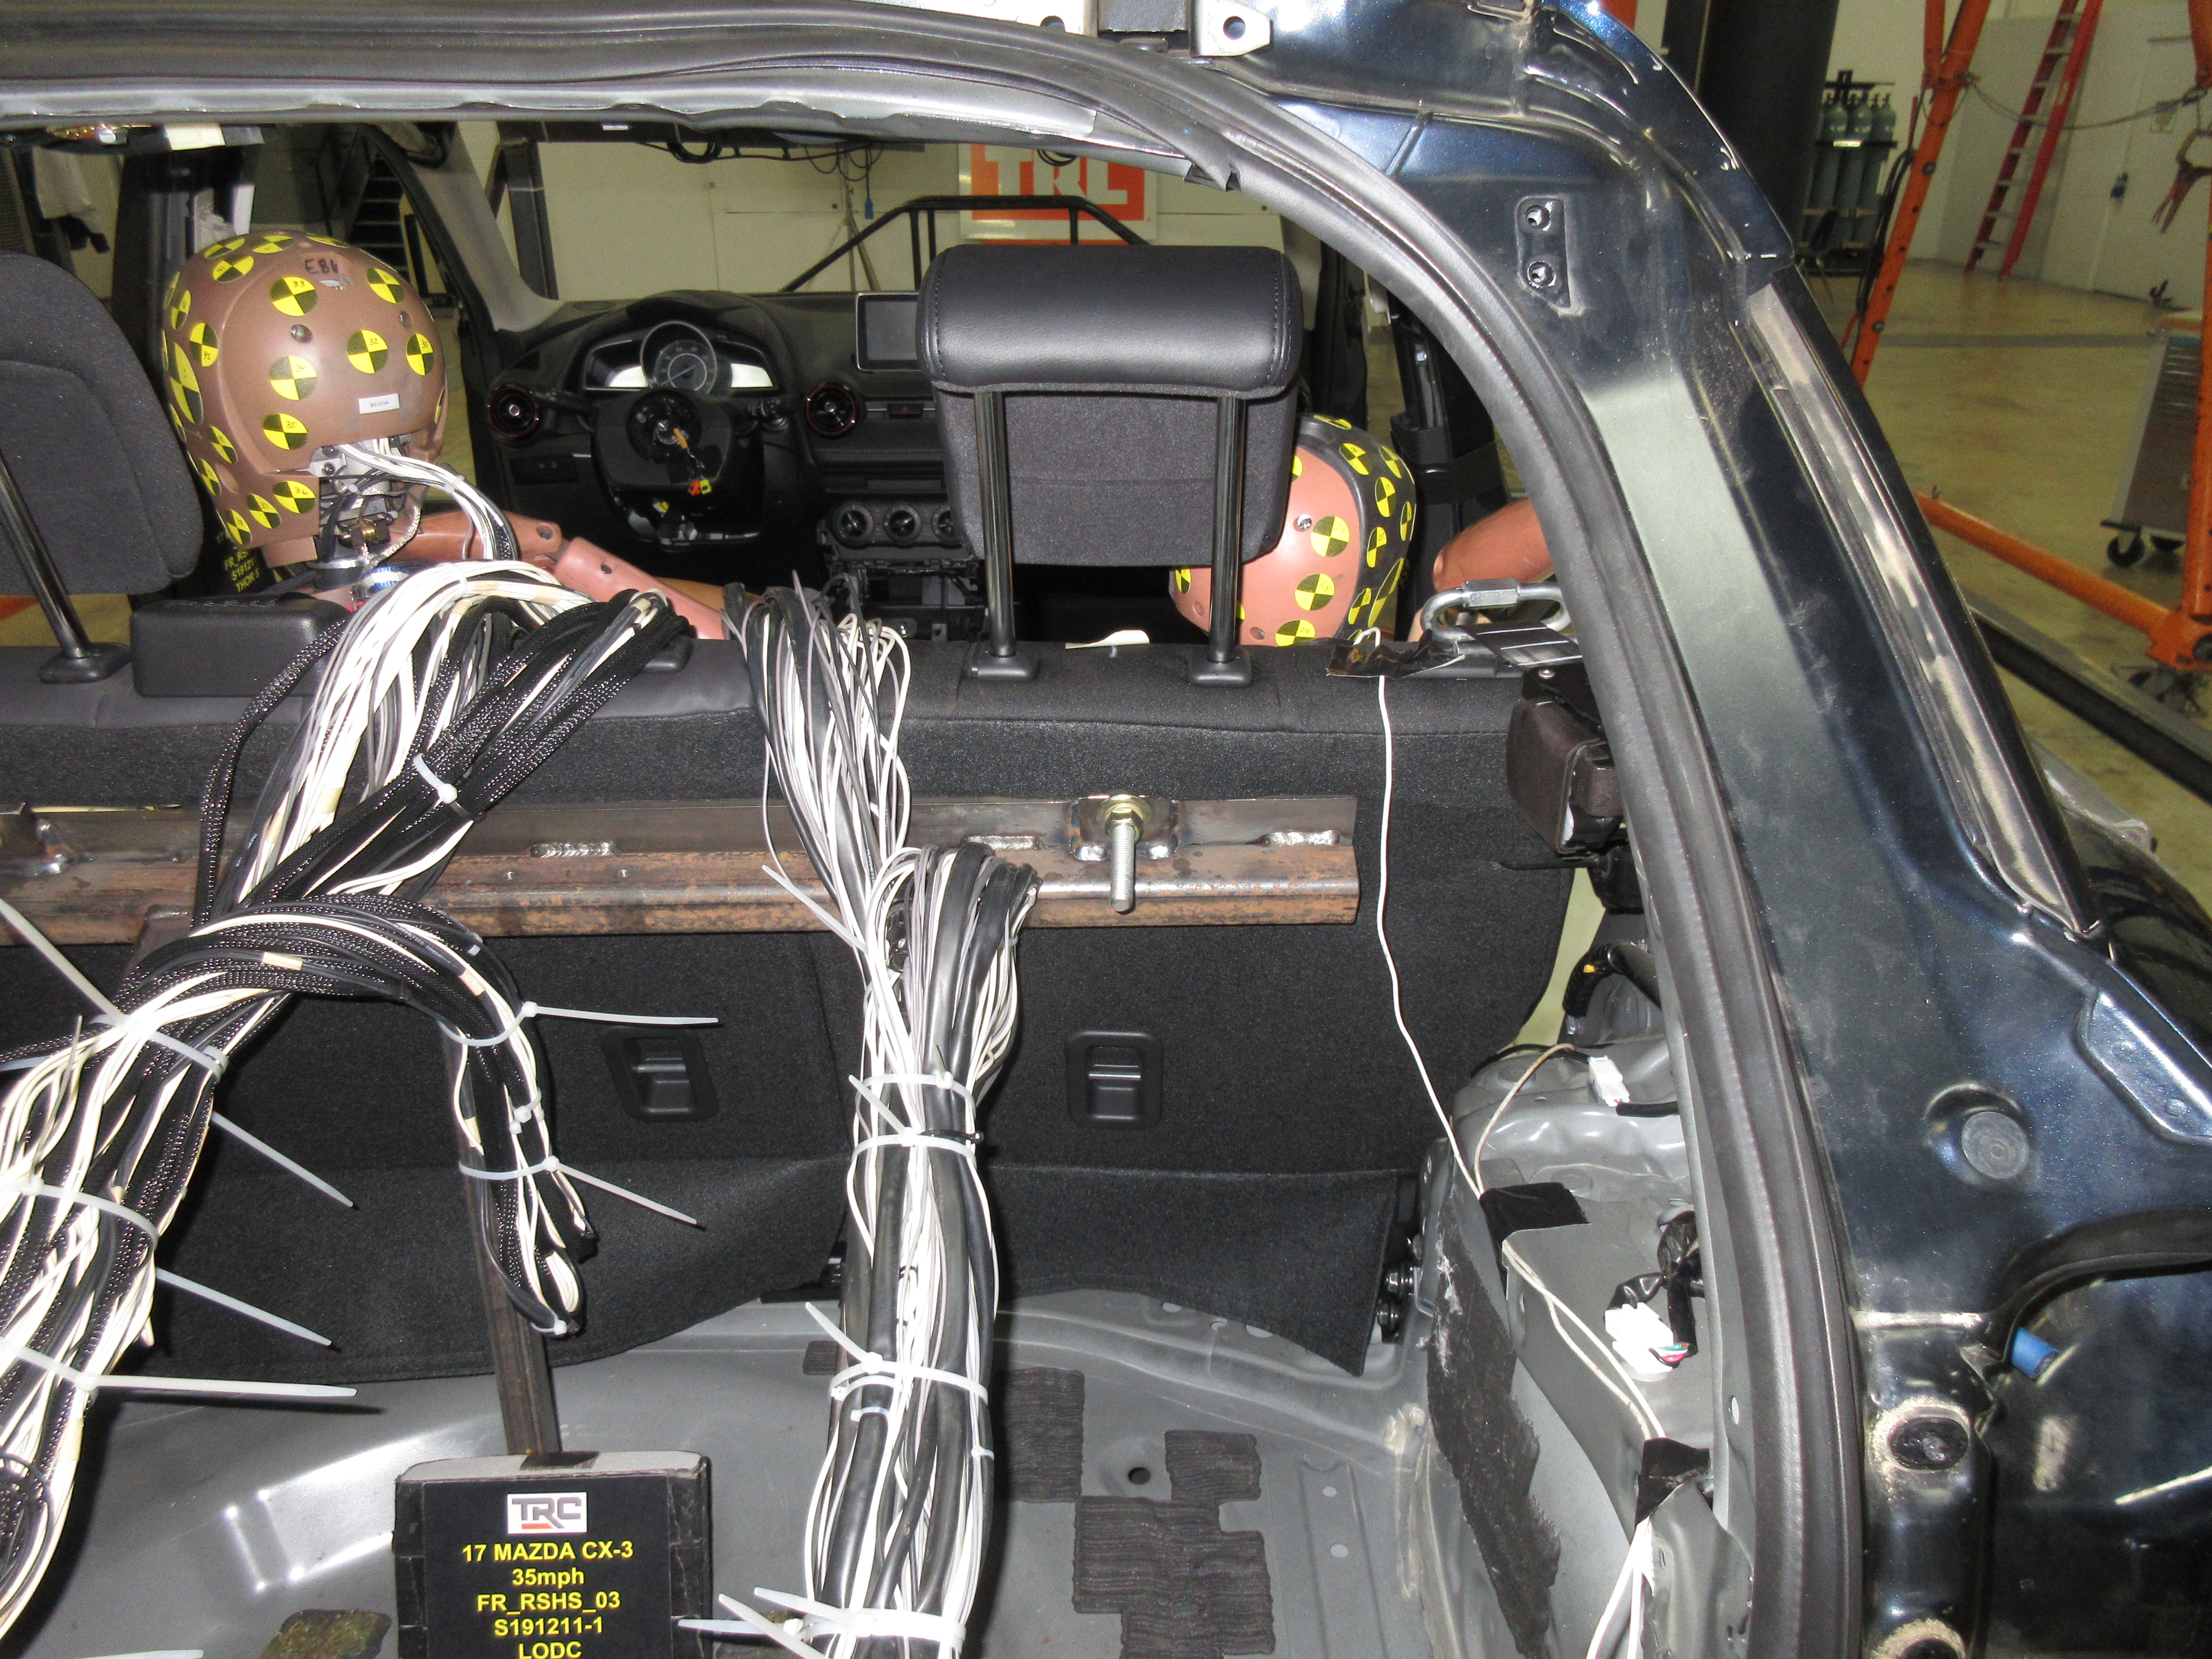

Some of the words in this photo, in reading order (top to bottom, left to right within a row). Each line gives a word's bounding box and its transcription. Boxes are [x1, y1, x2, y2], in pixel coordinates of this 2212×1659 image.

[292, 280, 306, 288] 33
[296, 364, 306, 373] 34
[286, 420, 298, 429] 35
[294, 486, 309, 495] 36
[1320, 579, 1332, 592] 28
[512, 1497, 582, 1529] TRC
[462, 1544, 487, 1563] 17
[494, 1542, 576, 1561] MAZDA
[582, 1540, 634, 1559] CX-3
[512, 1567, 585, 1589] 35mph
[476, 1591, 621, 1615] FR_RSHS_03
[493, 1616, 604, 1637] S191211-1
[518, 1641, 582, 1659] LODC
